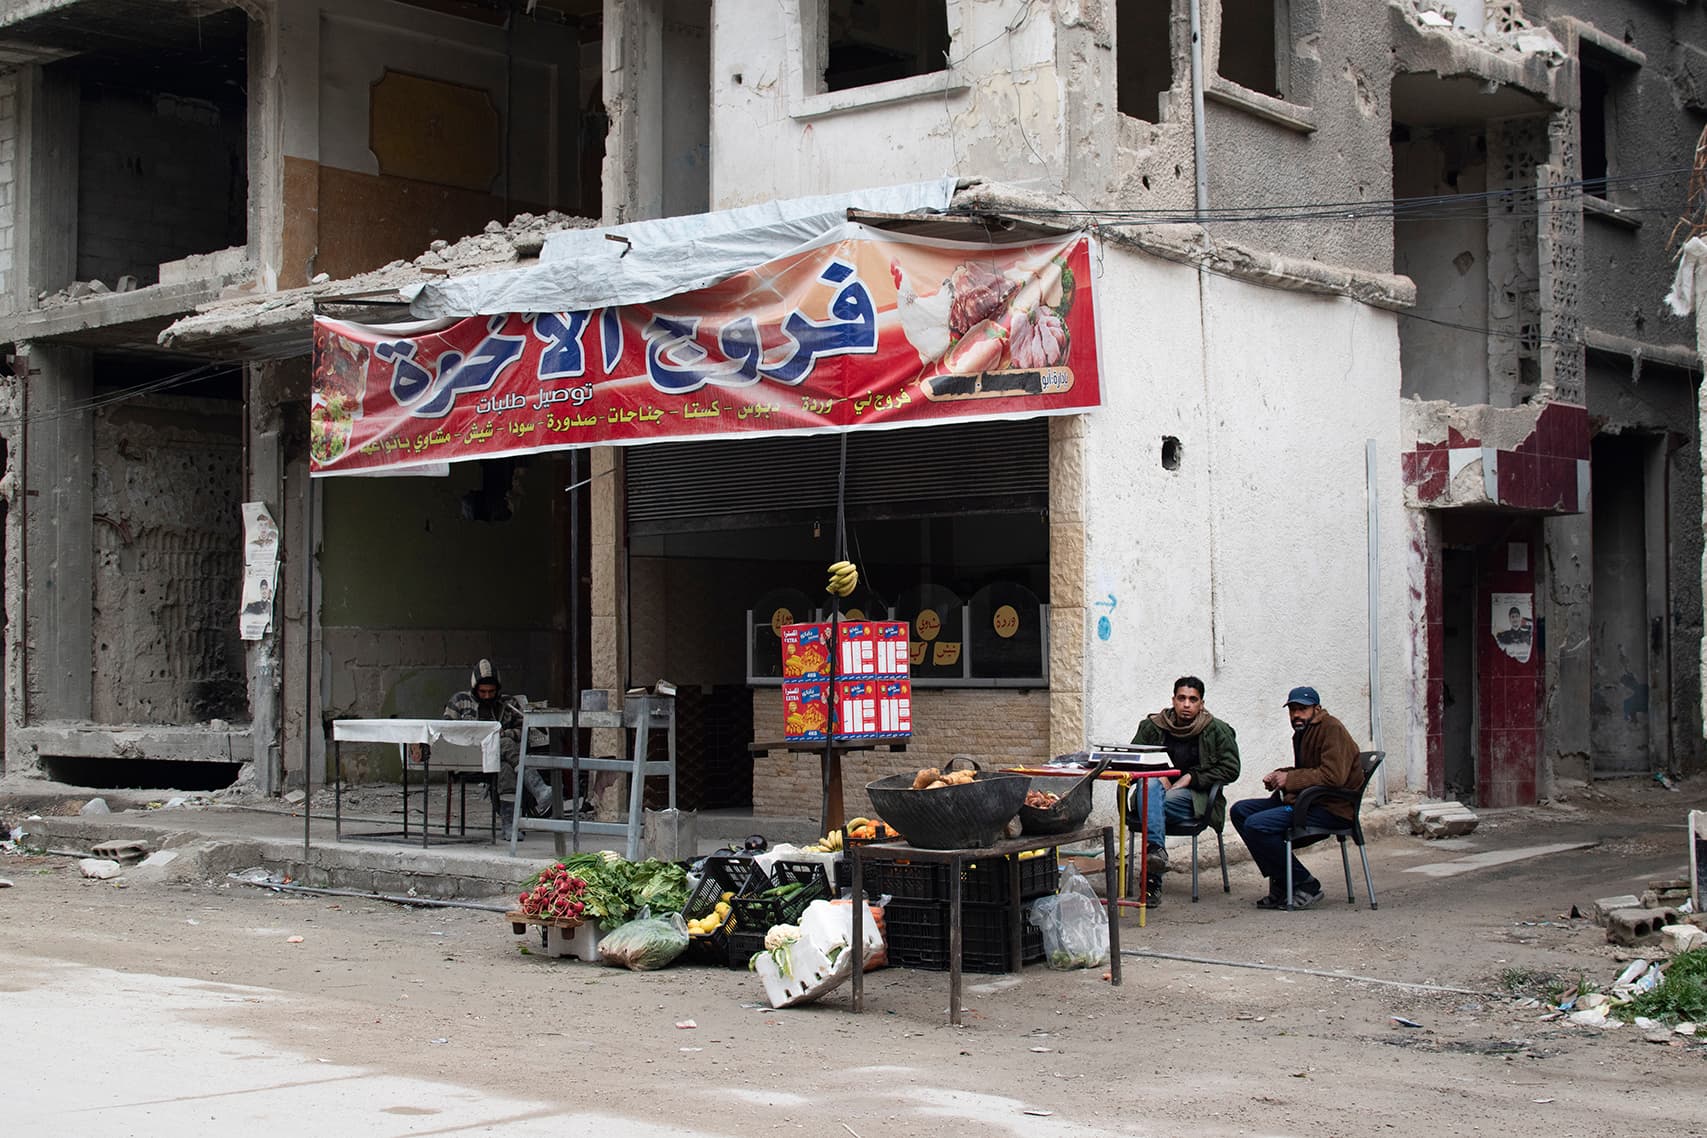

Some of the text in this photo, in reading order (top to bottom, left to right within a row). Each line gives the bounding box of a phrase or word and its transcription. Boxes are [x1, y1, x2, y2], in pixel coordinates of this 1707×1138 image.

[642, 257, 879, 394] فروج
[476, 382, 594, 415] توصيل طلبات
[801, 395, 833, 415] وردة
[874, 388, 912, 411] فروج
[546, 413, 597, 432] صدورة
[607, 405, 665, 424] جناحات
[413, 428, 451, 454] مشاوي
[463, 420, 494, 445] شيش
